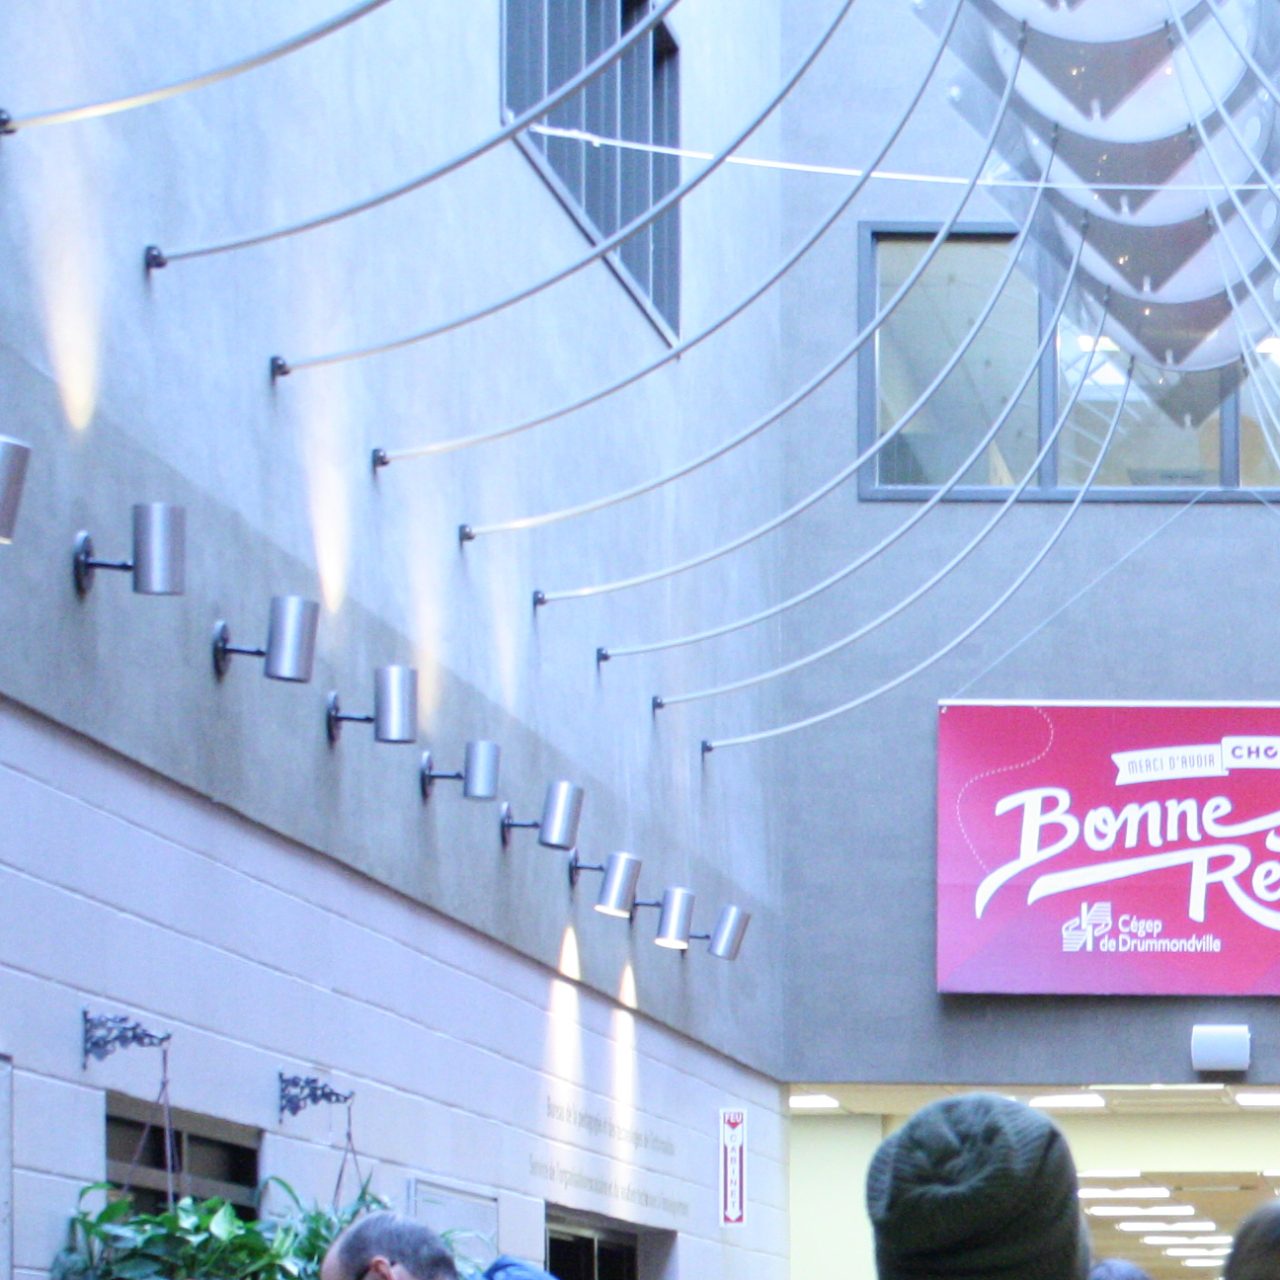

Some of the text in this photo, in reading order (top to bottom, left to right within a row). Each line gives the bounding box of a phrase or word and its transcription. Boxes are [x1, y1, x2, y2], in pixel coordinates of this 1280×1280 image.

[1127, 758, 1165, 775] MERCI
[1118, 914, 1163, 938] Cégep
[1100, 934, 1222, 952] de Drummondville
[724, 1111, 744, 1125] FEU
